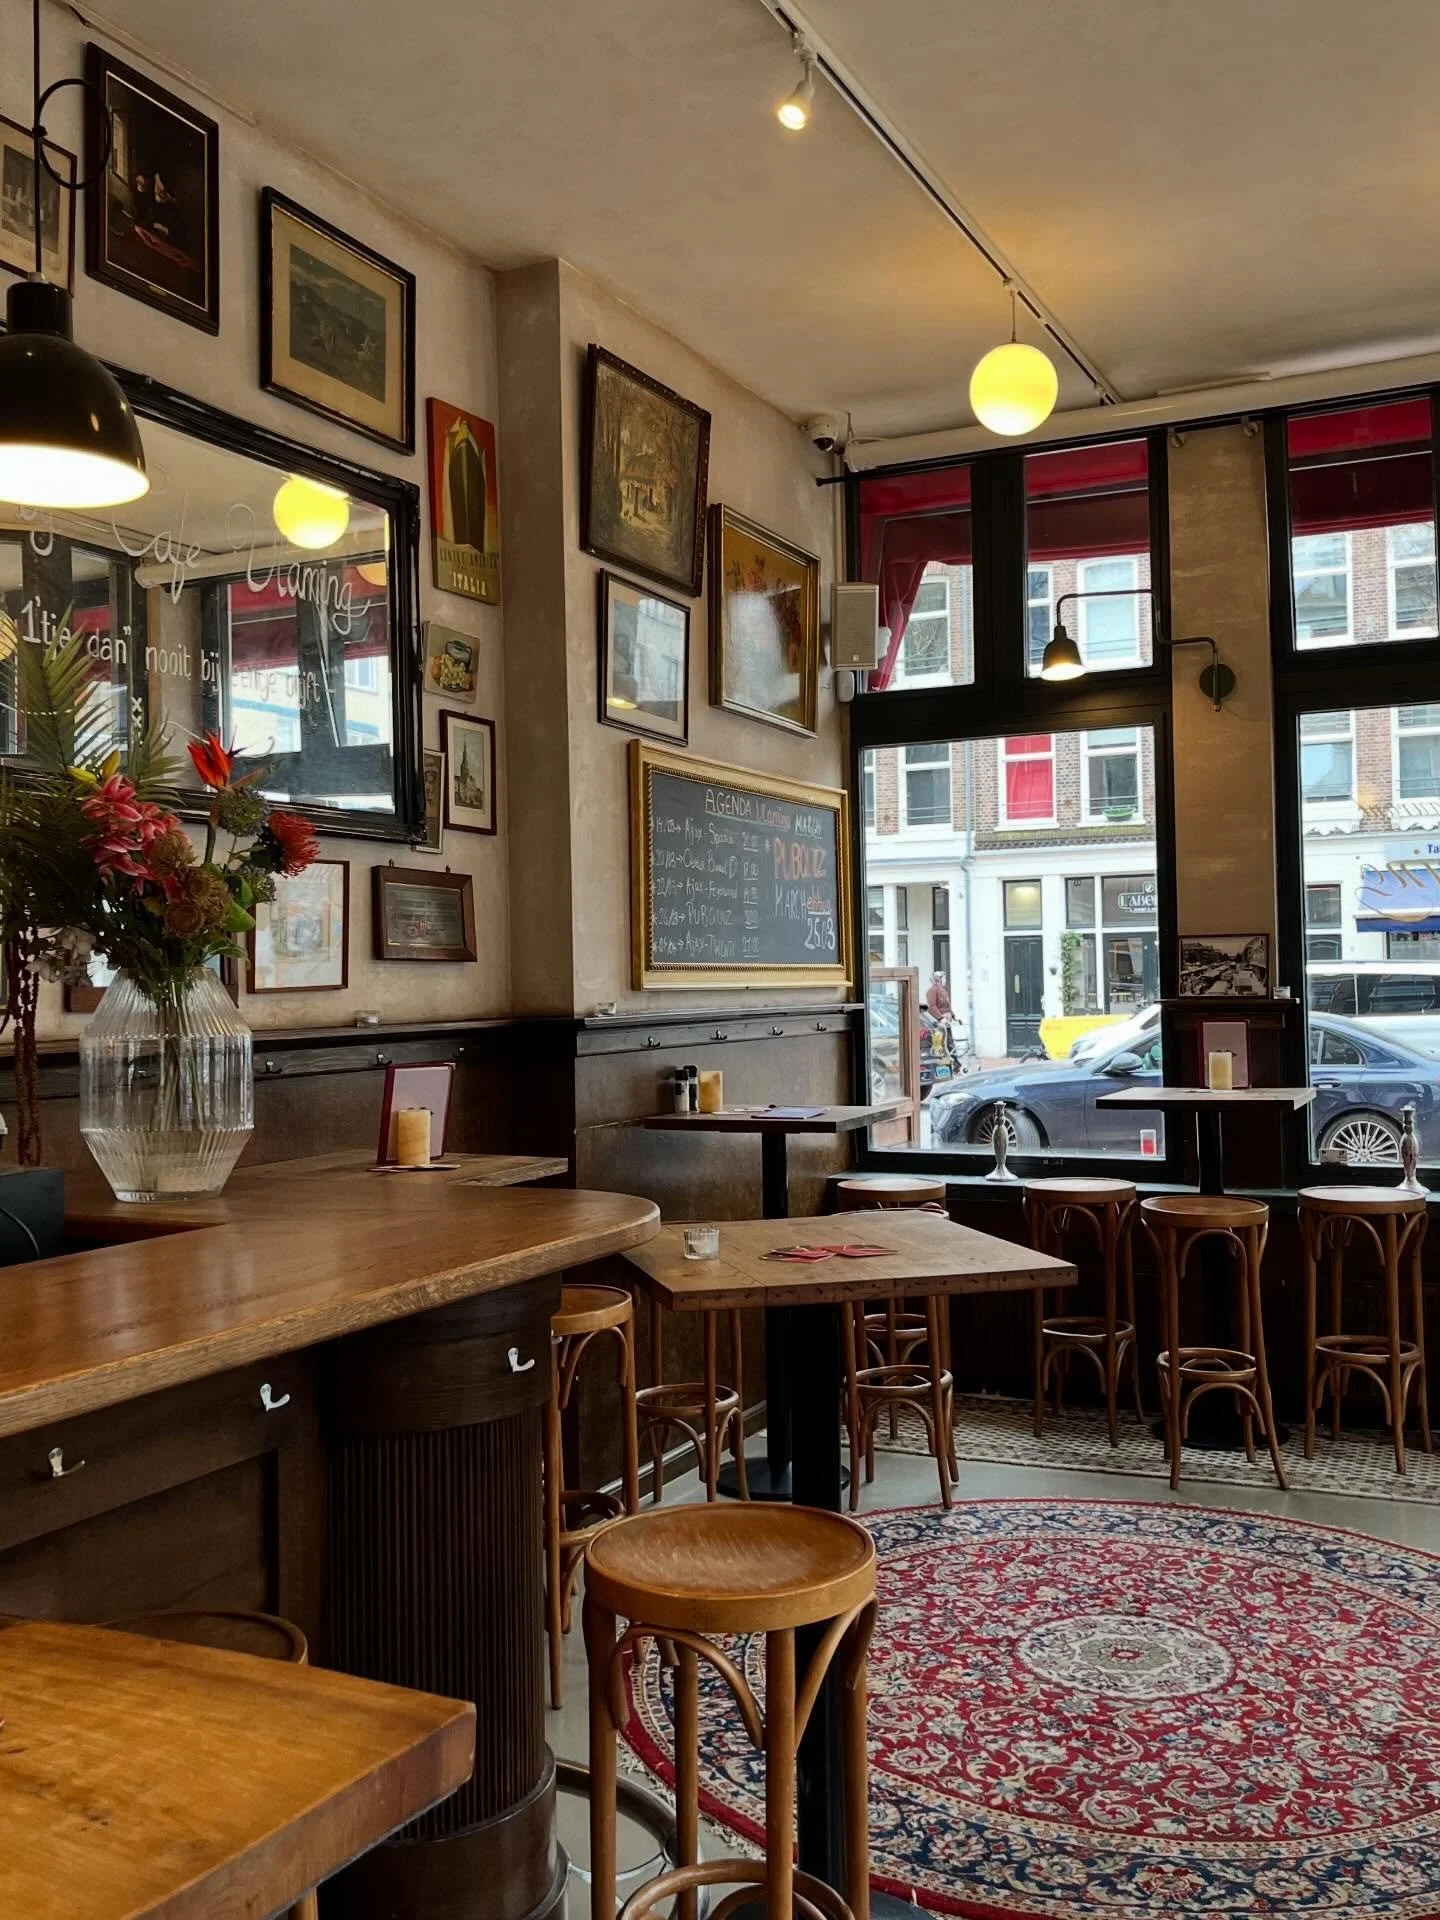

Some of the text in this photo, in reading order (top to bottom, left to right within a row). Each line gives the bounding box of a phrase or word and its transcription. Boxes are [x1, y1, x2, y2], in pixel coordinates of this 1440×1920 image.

[452, 571, 487, 597] ITALIA
[145, 643, 192, 678] nooit
[705, 788, 752, 817] AGENDA
[1427, 843, 1440, 855] Ta
[686, 901, 734, 928] PUBQUIZ
[775, 884, 807, 921] MARCH
